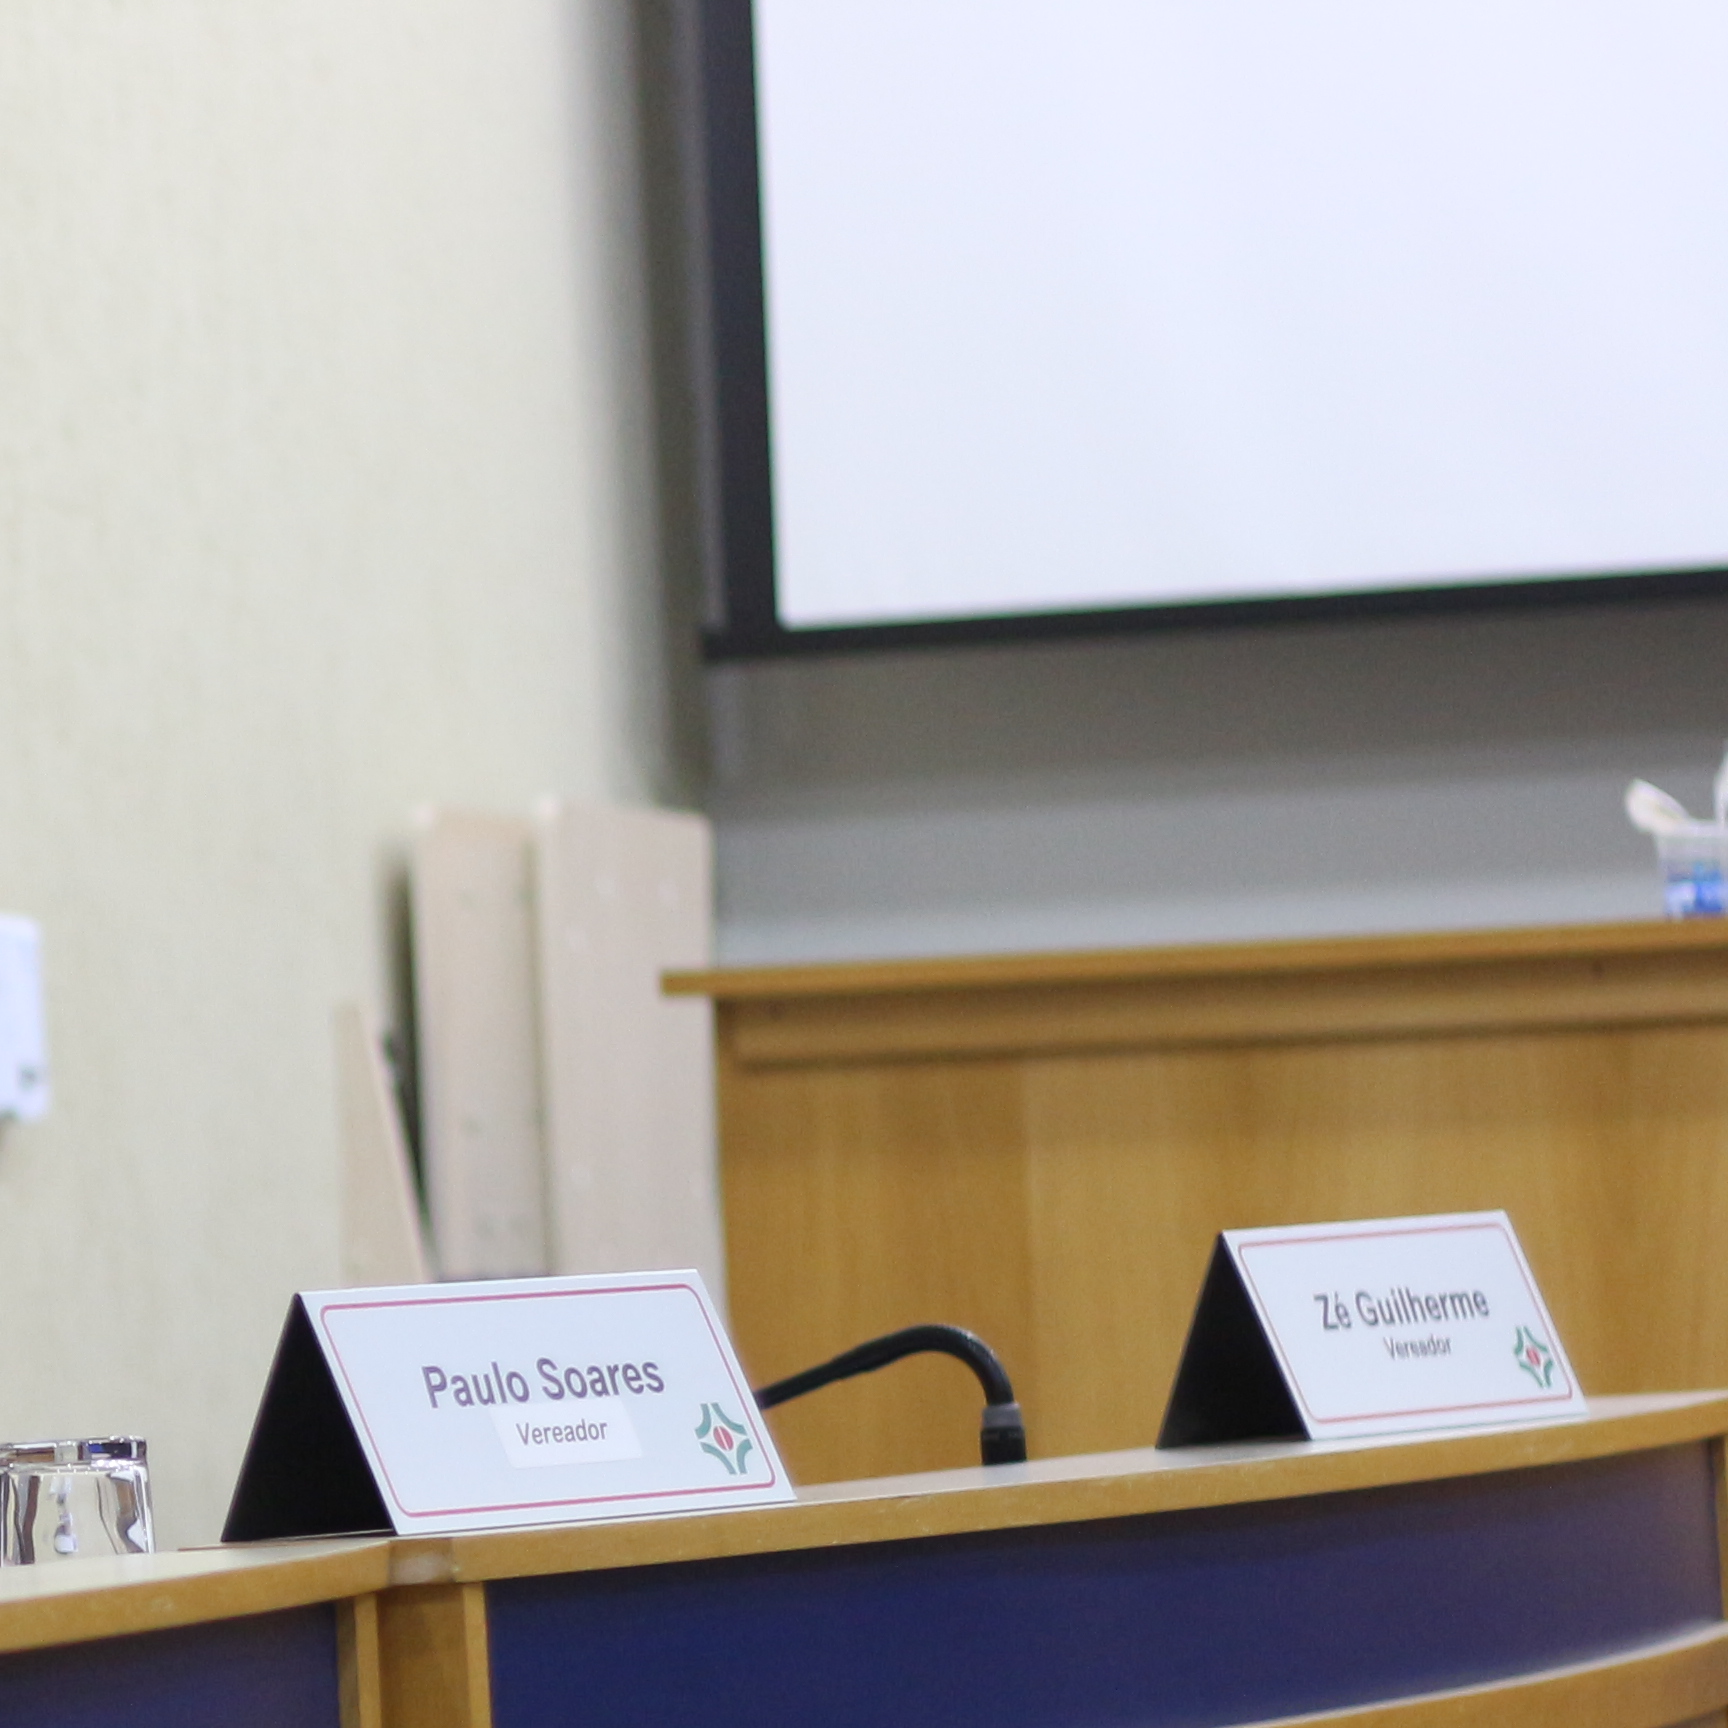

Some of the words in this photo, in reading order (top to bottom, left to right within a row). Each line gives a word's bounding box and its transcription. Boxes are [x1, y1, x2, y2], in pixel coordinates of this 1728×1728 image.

[1313, 1291, 1351, 1330] Zé
[1355, 1286, 1489, 1327] Guilherme
[1383, 1334, 1451, 1360] Vereador
[422, 1361, 530, 1409] Paulo
[536, 1357, 665, 1401] Soares
[516, 1418, 607, 1445] Vereador
